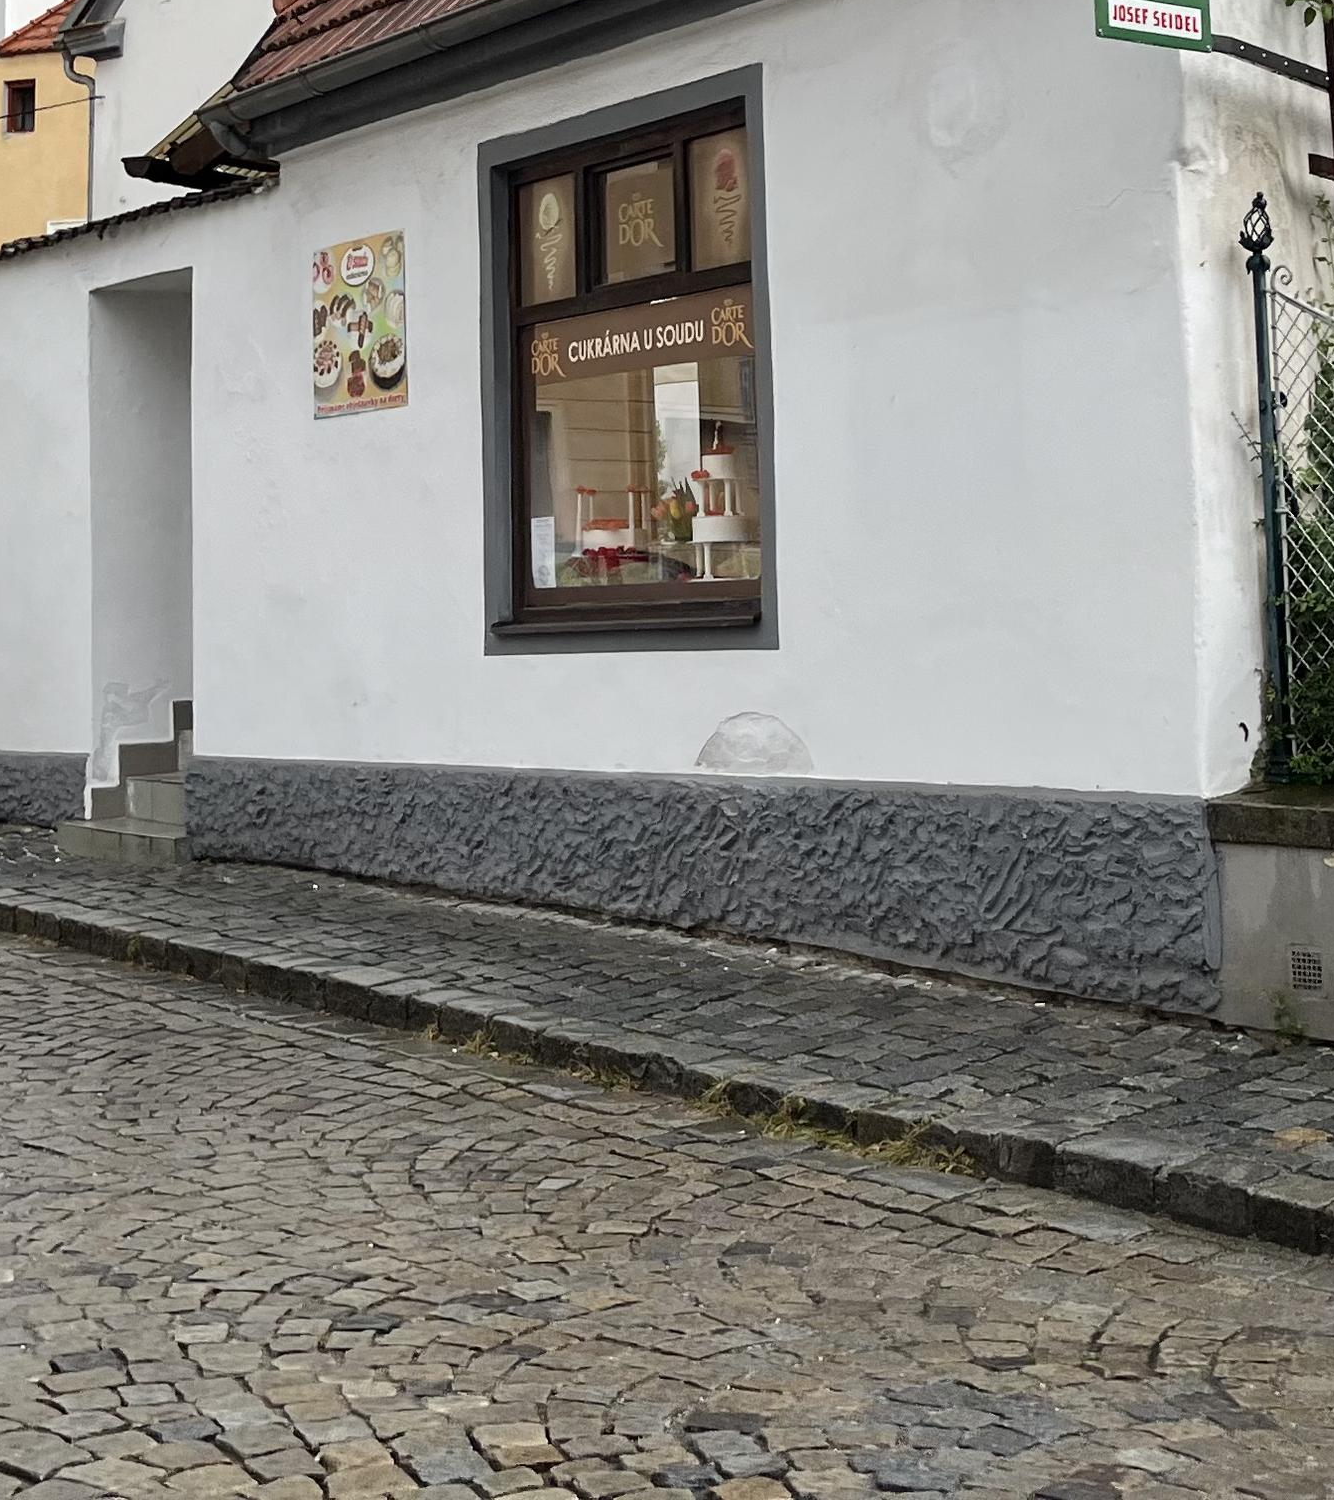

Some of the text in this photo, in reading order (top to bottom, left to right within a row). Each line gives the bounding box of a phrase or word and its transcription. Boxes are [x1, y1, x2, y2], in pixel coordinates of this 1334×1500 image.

[1113, 4, 1199, 33] JOSEF SEIDEL
[619, 199, 654, 222] CARTE
[711, 304, 746, 325] CARTE
[531, 336, 560, 357] CARTE
[568, 320, 704, 362] CUKRÁRNA U SOUDU
[712, 322, 754, 348] D'OR
[531, 354, 567, 377] D'OR
